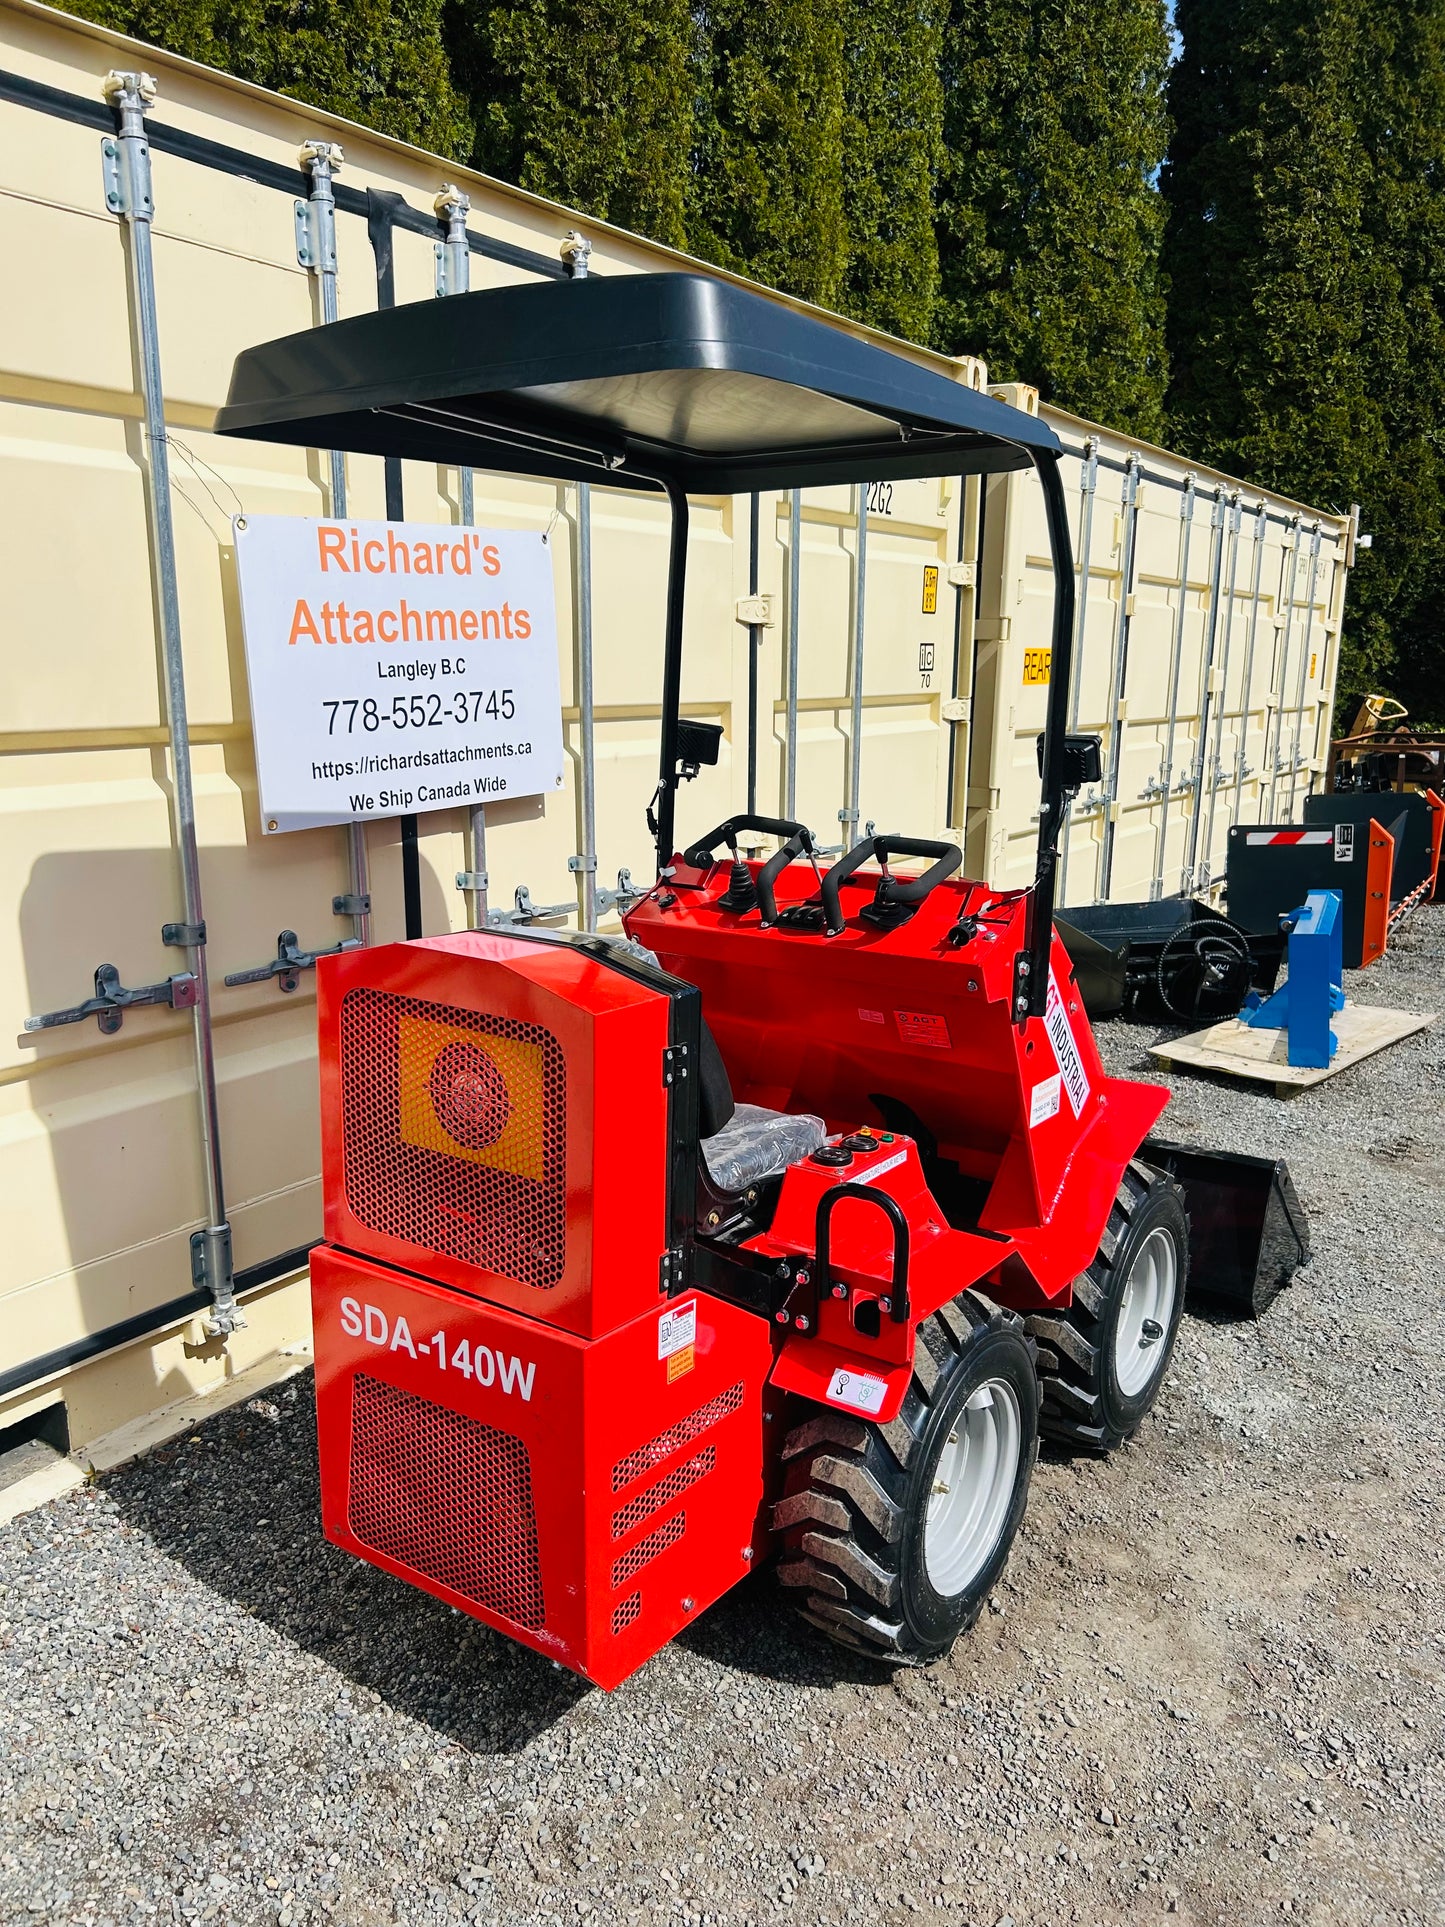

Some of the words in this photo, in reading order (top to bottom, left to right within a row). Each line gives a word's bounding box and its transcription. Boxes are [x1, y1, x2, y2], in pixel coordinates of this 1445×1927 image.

[317, 526, 501, 576] Richard's
[288, 599, 532, 645] Attachments
[377, 659, 437, 681] Langley
[441, 658, 466, 675] B.C
[921, 674, 931, 689] 70
[1024, 653, 1051, 681] REAR
[322, 689, 515, 735] 778-552-3745
[312, 742, 532, 780] https://richardsattachments.ca
[349, 795, 374, 812] We
[379, 789, 413, 811] Ship
[417, 782, 470, 803] Canada
[474, 776, 507, 794] Wide
[340, 1297, 536, 1401] SDA-140W
